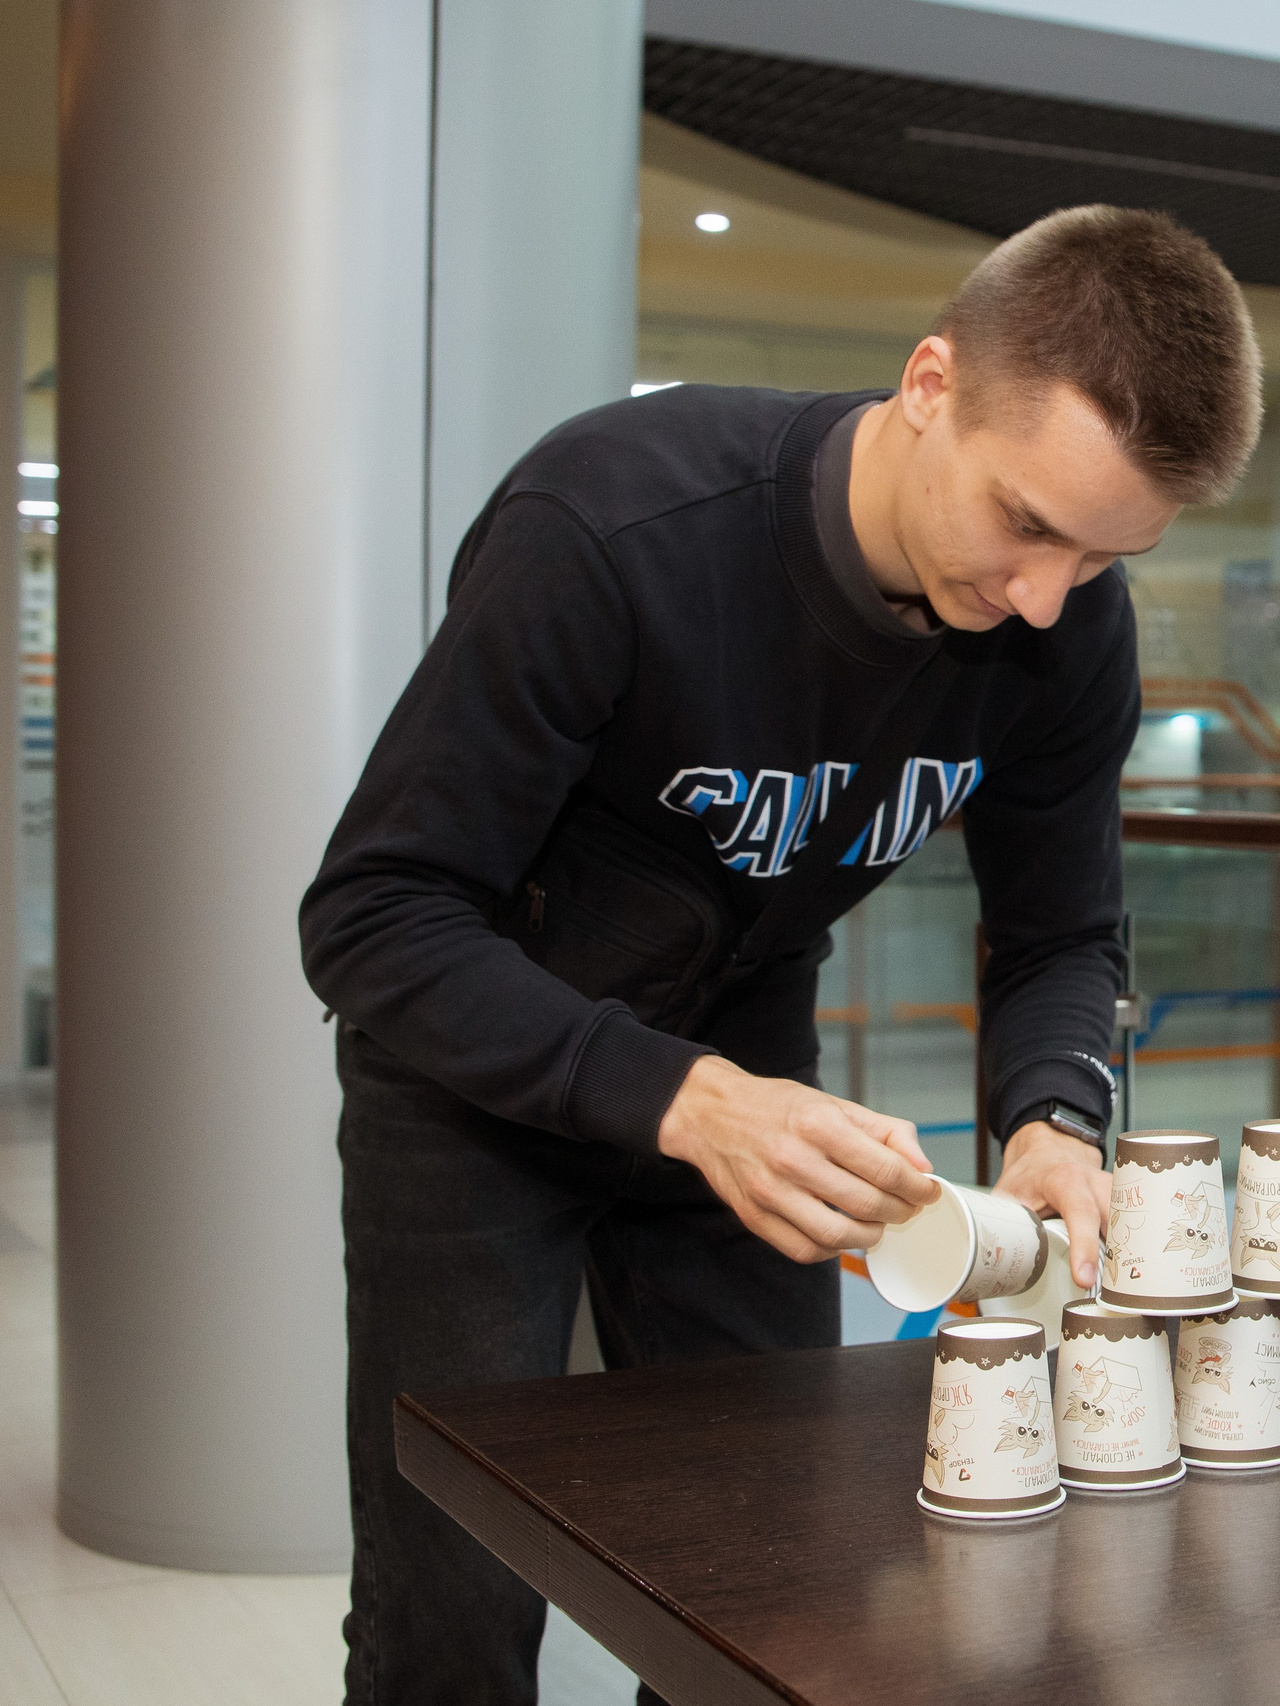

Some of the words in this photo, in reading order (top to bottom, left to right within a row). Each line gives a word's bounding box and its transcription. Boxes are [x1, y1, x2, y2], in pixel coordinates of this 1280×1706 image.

[1121, 1256, 1145, 1266] ТЕНЗОР
[1120, 1406, 1146, 1429] OOPS
[1215, 1409, 1234, 1419] ПОТОМ
[1205, 1416, 1232, 1432] КОФЕ,
[1193, 1425, 1221, 1441] ЗАХВАТИМ
[1222, 1432, 1244, 1441] СПЕРВА
[1076, 1438, 1110, 1452] СТАРАЛСЯ
[1111, 1442, 1120, 1451] НЕ
[1121, 1437, 1140, 1449] ЗНАЧИТ
[1125, 1449, 1136, 1462] НЕ
[948, 1457, 975, 1468] ТЕНЗОР
